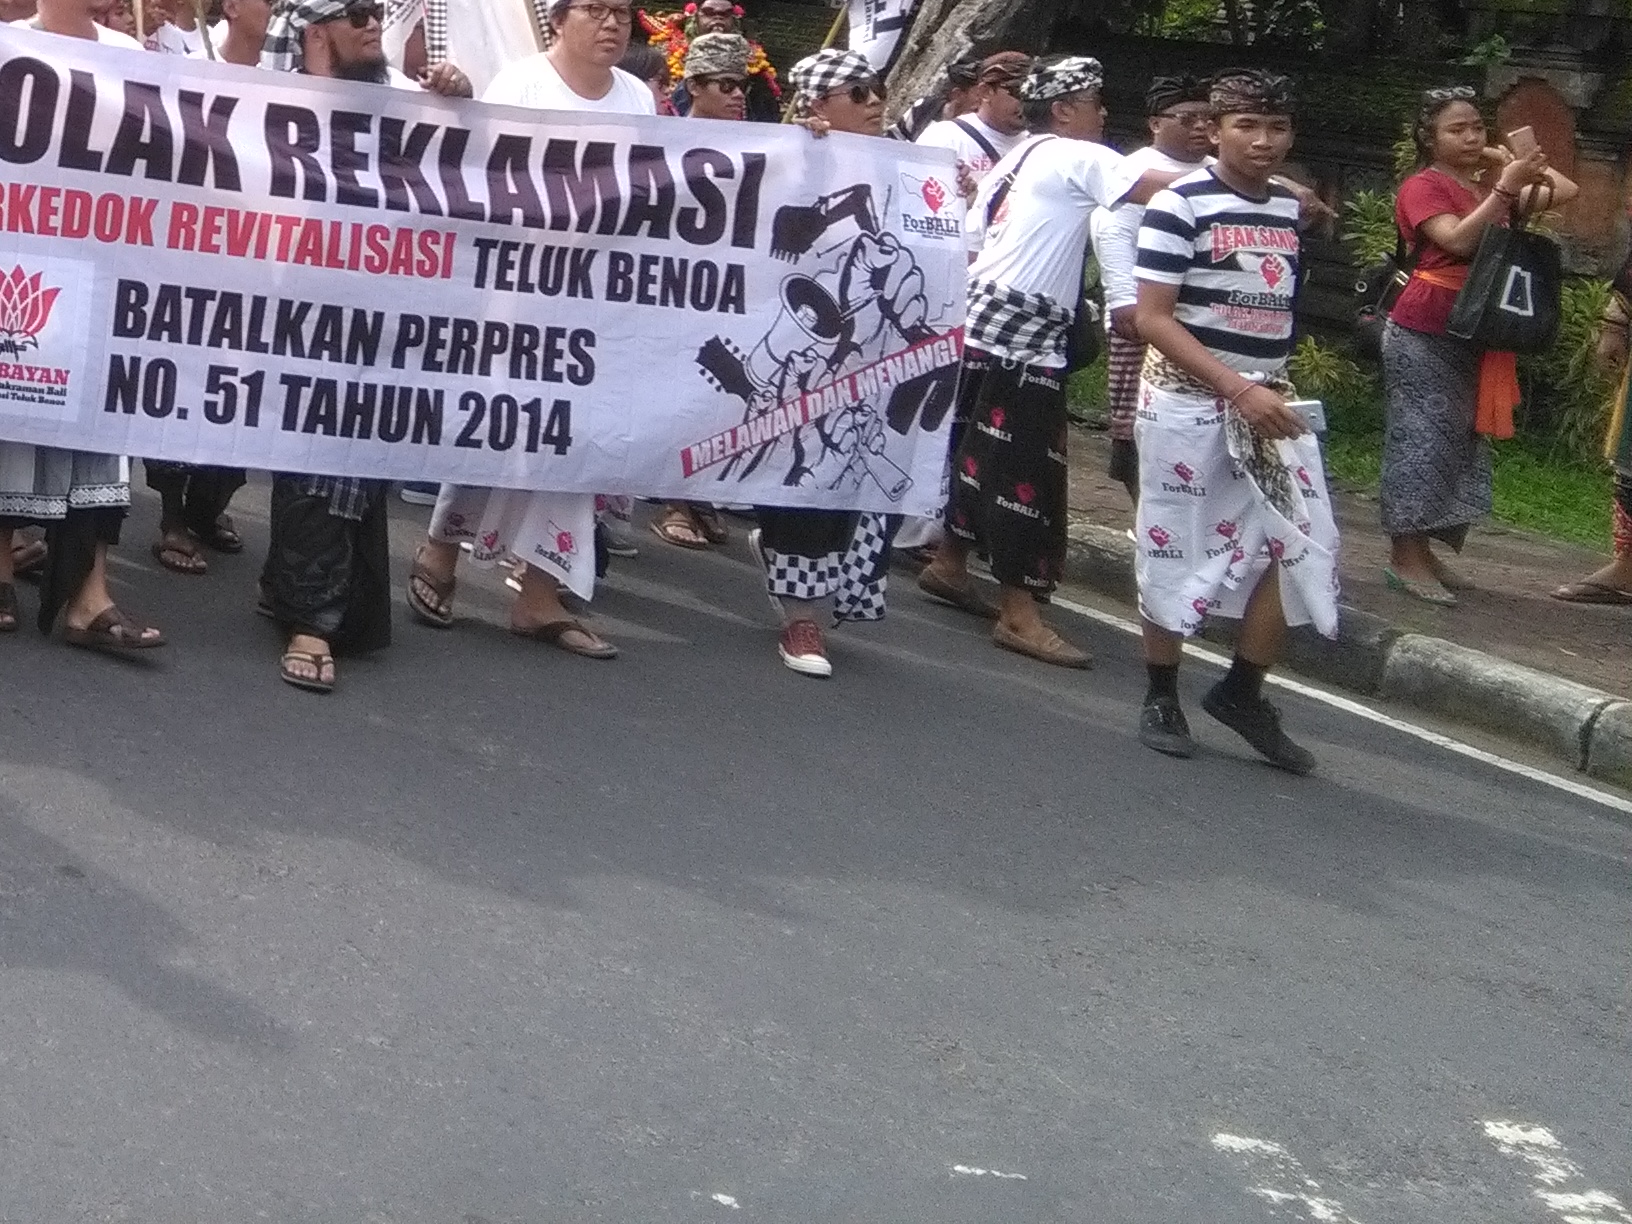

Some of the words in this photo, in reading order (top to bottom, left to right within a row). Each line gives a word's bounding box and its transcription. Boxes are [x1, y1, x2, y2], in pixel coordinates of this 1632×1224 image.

[264, 101, 767, 250] REKLAMASI
[901, 213, 960, 233] ForBALI
[166, 200, 458, 280] REVITALISASI
[473, 237, 600, 300] TELUK
[606, 251, 747, 315] BENOA
[112, 278, 384, 367] BATALKAN
[391, 313, 597, 386] PERPRES
[104, 354, 189, 420] NO.
[203, 363, 266, 428] 51
[279, 372, 445, 446] TAHUN
[454, 390, 573, 456] 2014
[688, 399, 805, 471] MELAWAN
[807, 380, 854, 422] DAN
[856, 336, 958, 397] MENANG!
[997, 495, 1040, 520] ForBALI
[1162, 482, 1208, 498] ForBALI
